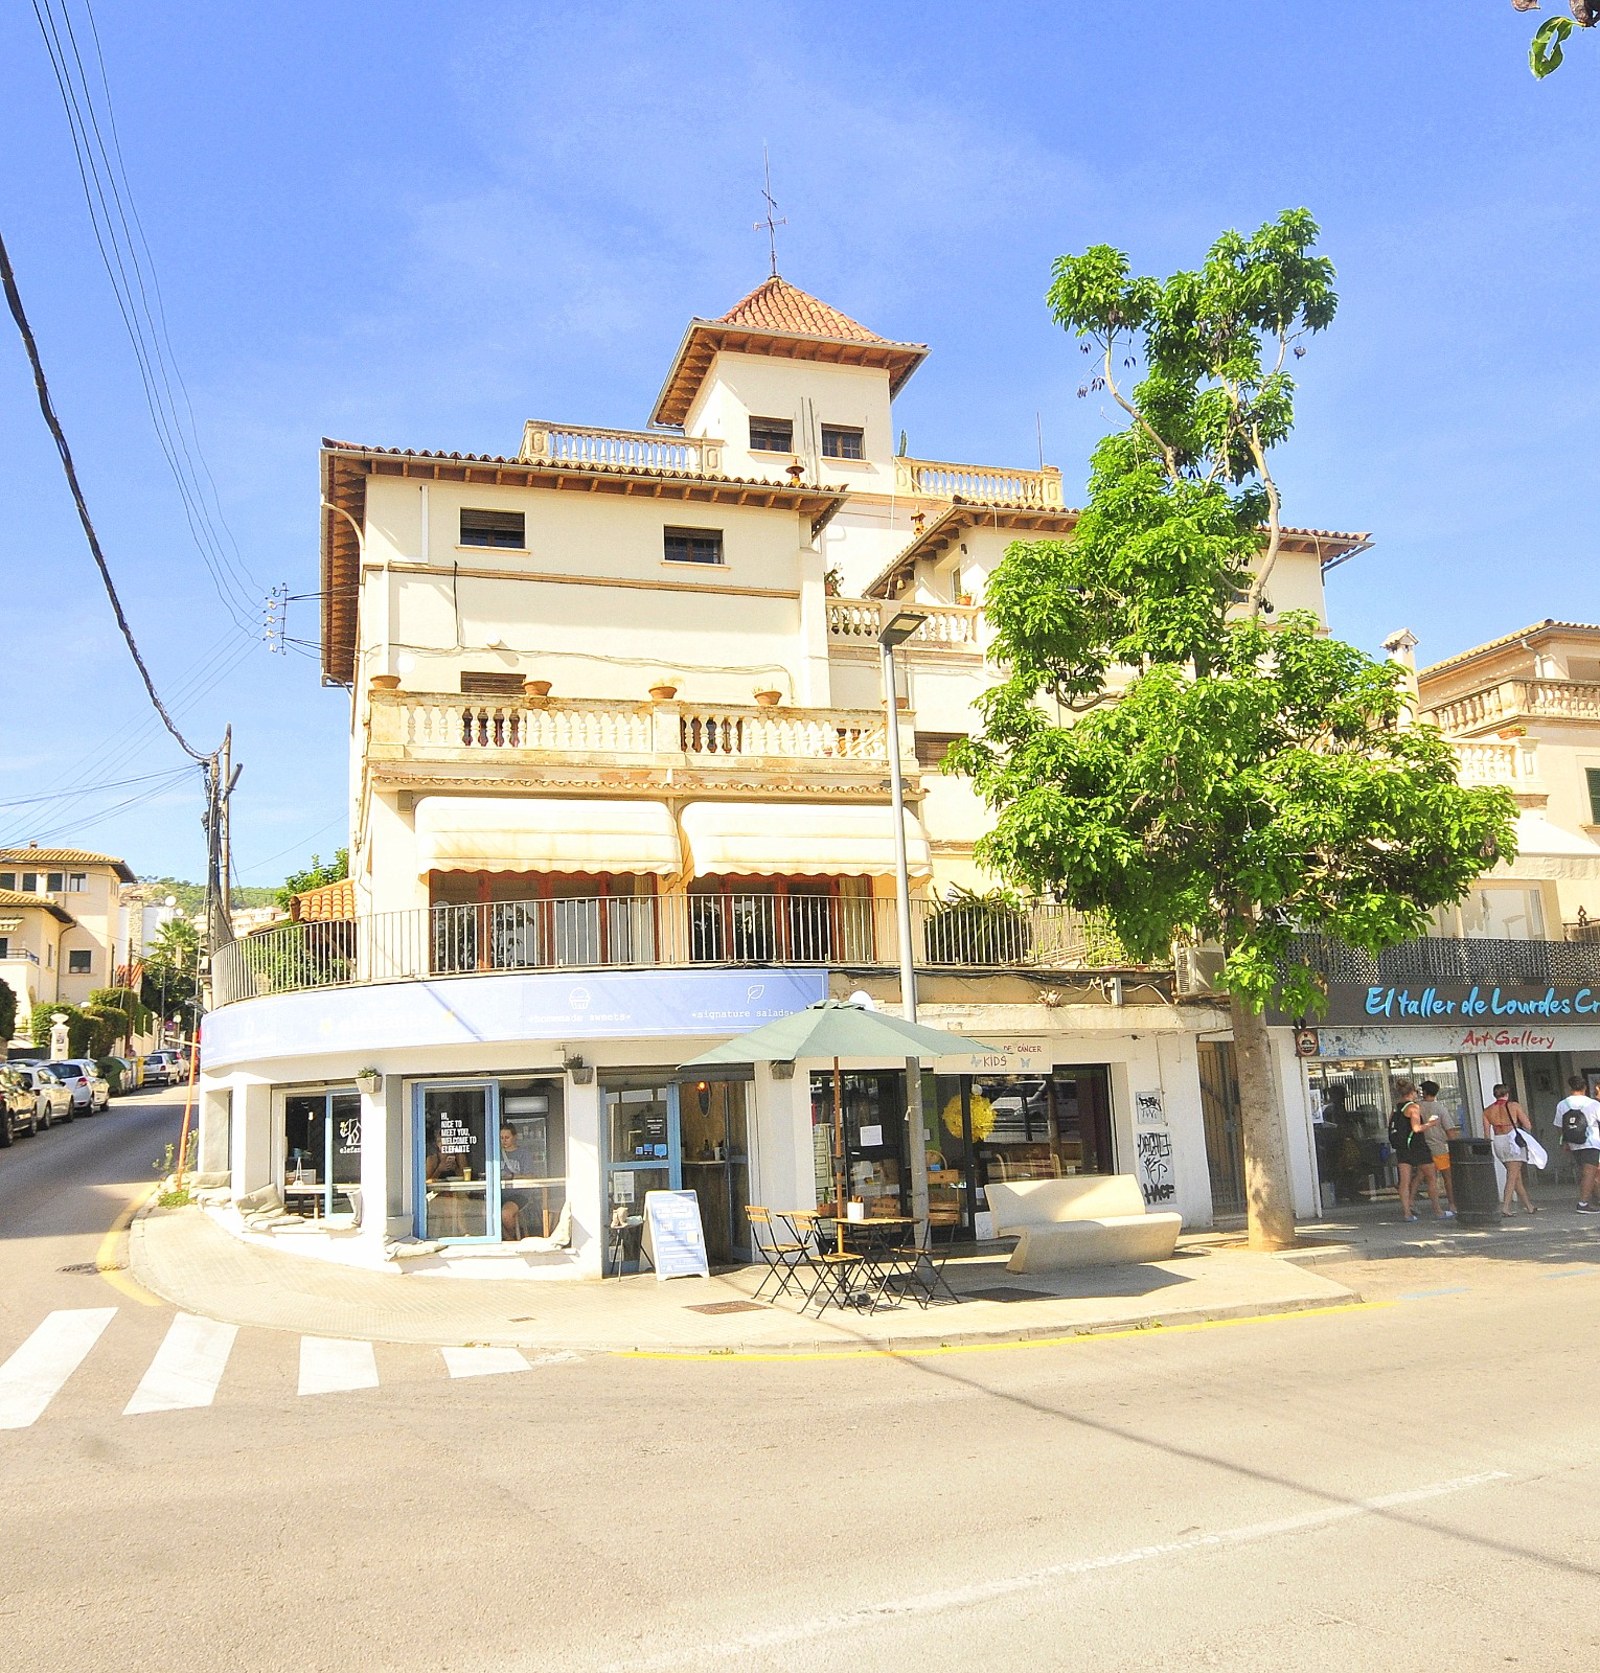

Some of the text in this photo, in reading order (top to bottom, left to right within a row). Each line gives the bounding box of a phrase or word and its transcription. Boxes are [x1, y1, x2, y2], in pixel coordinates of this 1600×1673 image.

[1365, 986, 1394, 1018] El
[1398, 987, 1457, 1018] taller
[1461, 986, 1488, 1017] de
[1492, 987, 1570, 1018] Lourdes
[1461, 1030, 1555, 1049] Art Gallery
[455, 1120, 462, 1128] TO
[441, 1128, 456, 1136] MEET
[441, 1136, 477, 1145] WELCOME TO
